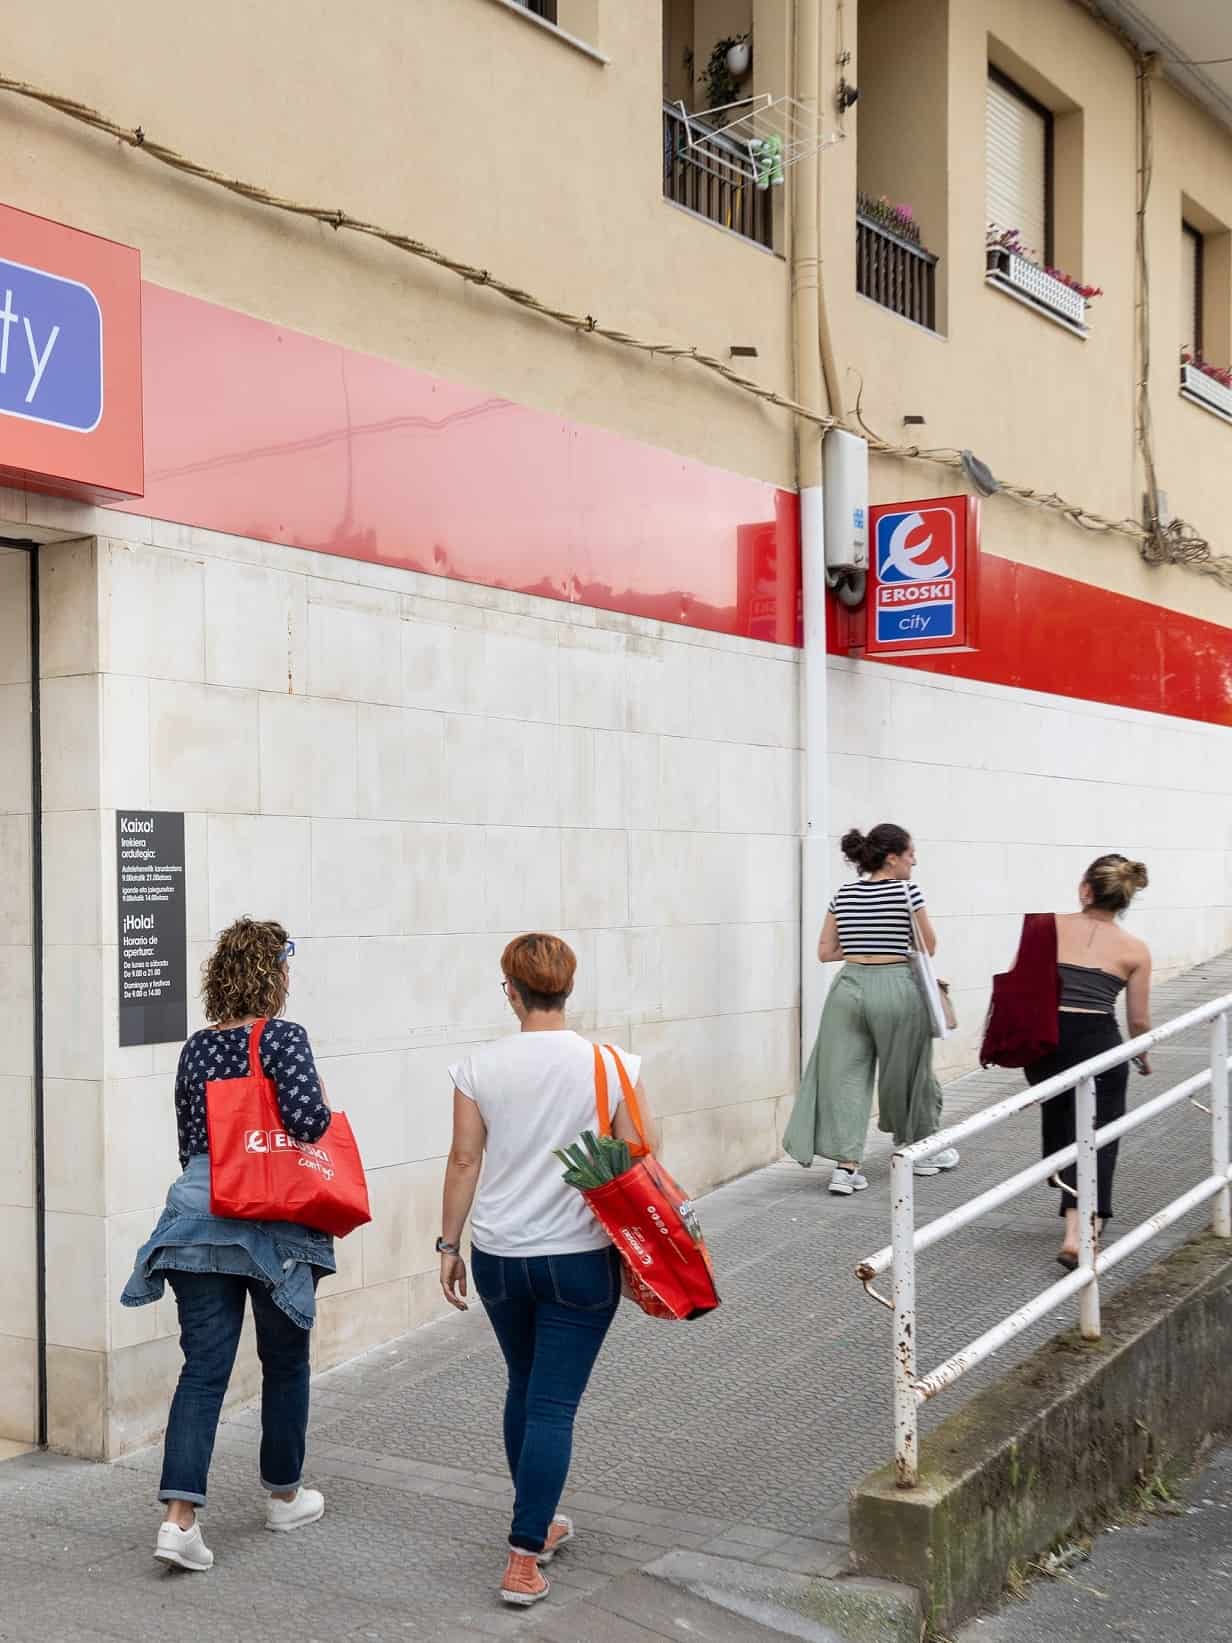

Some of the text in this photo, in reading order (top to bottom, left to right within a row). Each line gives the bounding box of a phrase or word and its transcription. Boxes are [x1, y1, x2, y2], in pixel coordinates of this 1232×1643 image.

[881, 584, 950, 603] EROSKI
[898, 614, 931, 631] city
[120, 818, 154, 833] Kaixo!
[123, 914, 154, 934] ¡Hola!
[123, 935, 158, 946] Horario de
[123, 947, 155, 959] apertura:
[123, 961, 131, 969] De
[123, 970, 131, 978] De
[123, 990, 131, 999] De
